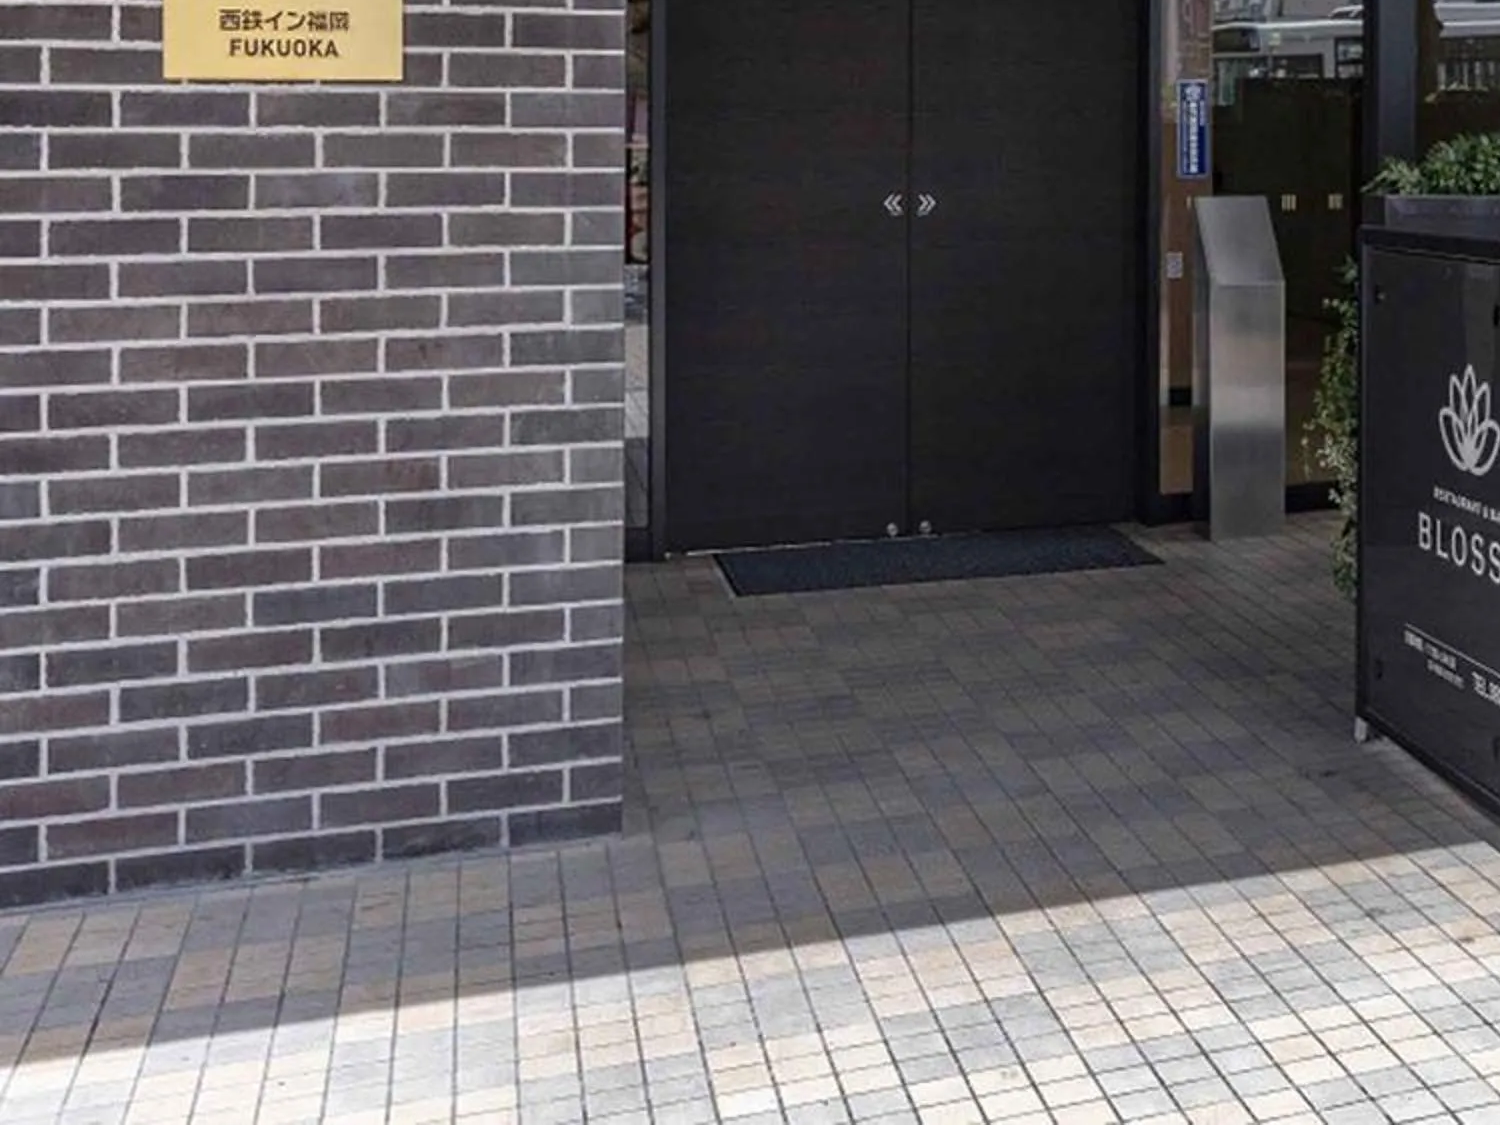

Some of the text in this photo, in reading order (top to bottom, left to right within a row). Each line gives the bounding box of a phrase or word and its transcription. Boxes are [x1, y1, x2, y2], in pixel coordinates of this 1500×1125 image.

[218, 8, 350, 32] 西鉄イン福岡
[228, 38, 339, 58] FUKUOKA
